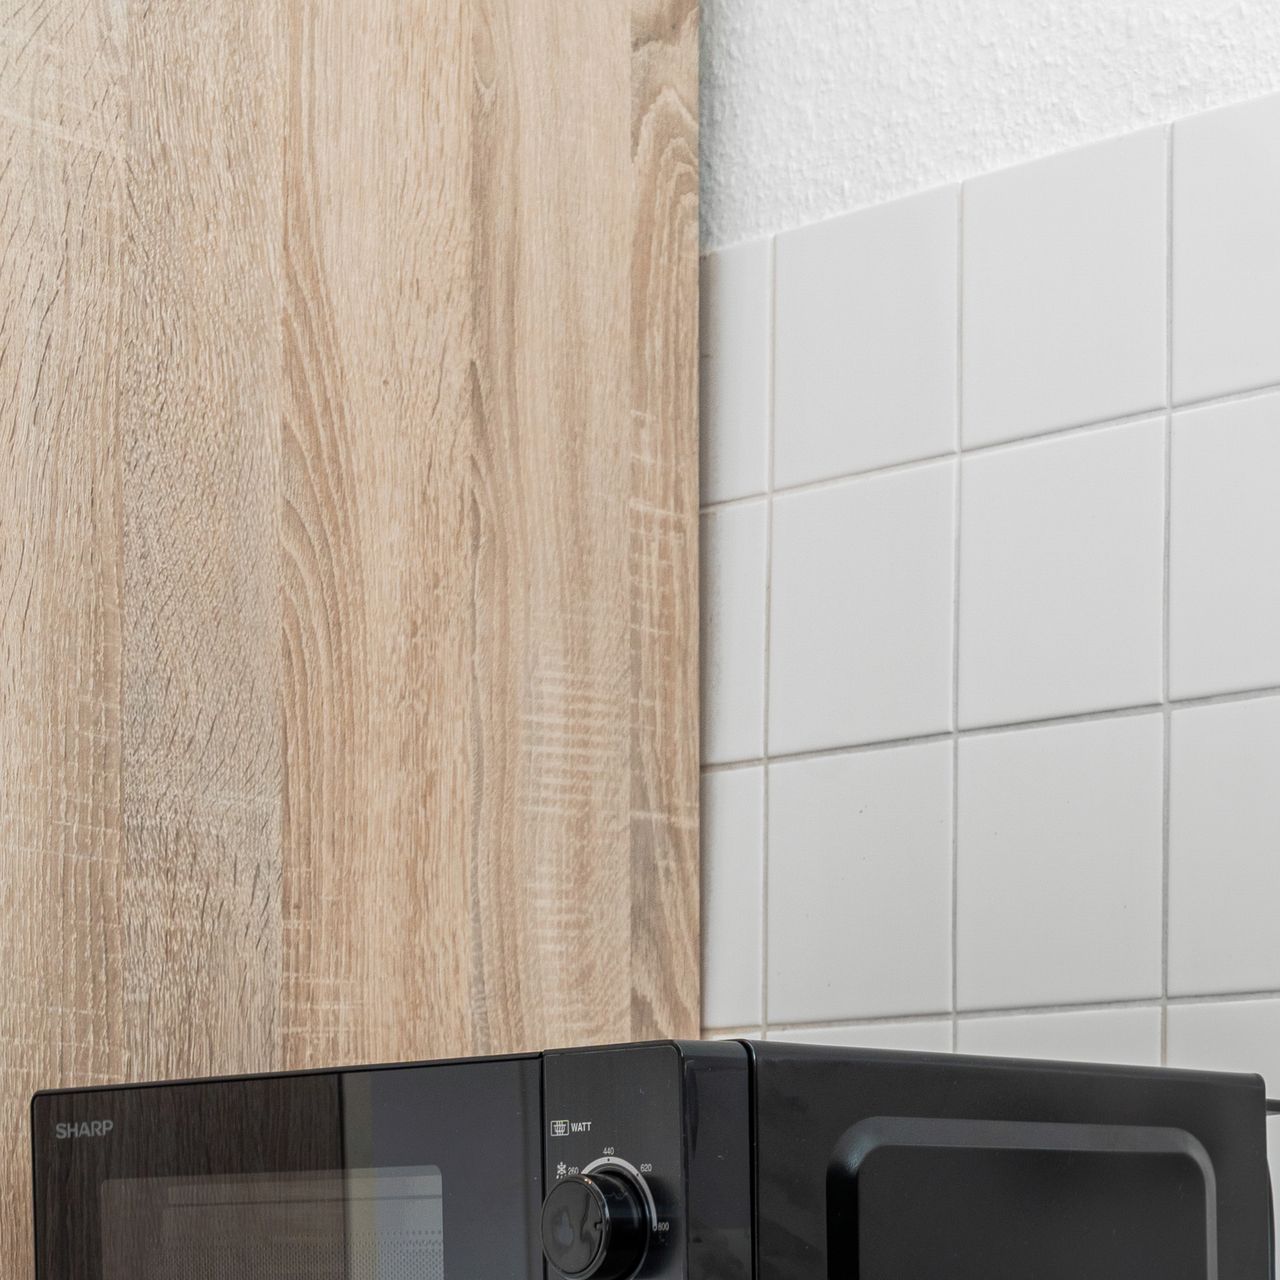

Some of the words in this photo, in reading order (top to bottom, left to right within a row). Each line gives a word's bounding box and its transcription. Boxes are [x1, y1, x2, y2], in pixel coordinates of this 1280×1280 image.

[55, 1119, 114, 1139] SHARP
[570, 1121, 592, 1132] WATT
[602, 1146, 615, 1156] 440
[640, 1163, 653, 1173] 620
